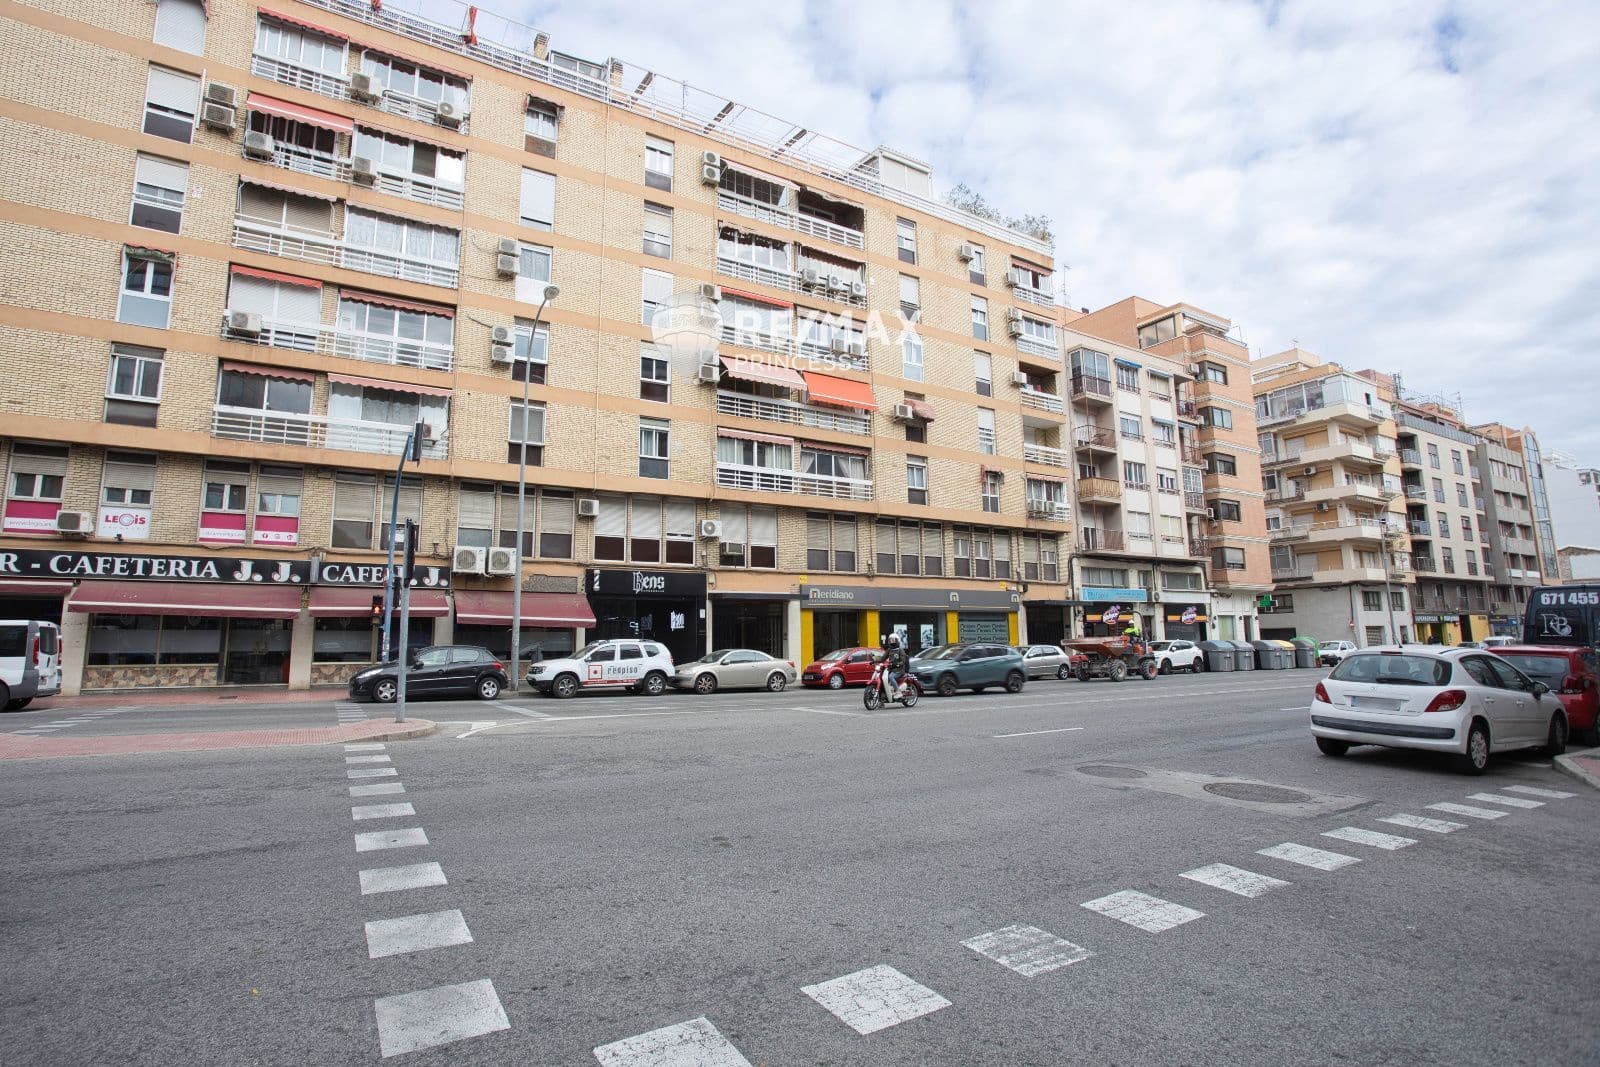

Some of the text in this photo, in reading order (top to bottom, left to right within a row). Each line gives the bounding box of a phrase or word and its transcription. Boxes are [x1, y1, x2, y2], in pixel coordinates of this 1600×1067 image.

[49, 554, 220, 579] CAFETERIA
[233, 560, 263, 582] J.
[271, 561, 301, 583] J.
[422, 567, 449, 587] J.
[1540, 592, 1599, 605] 671 455
